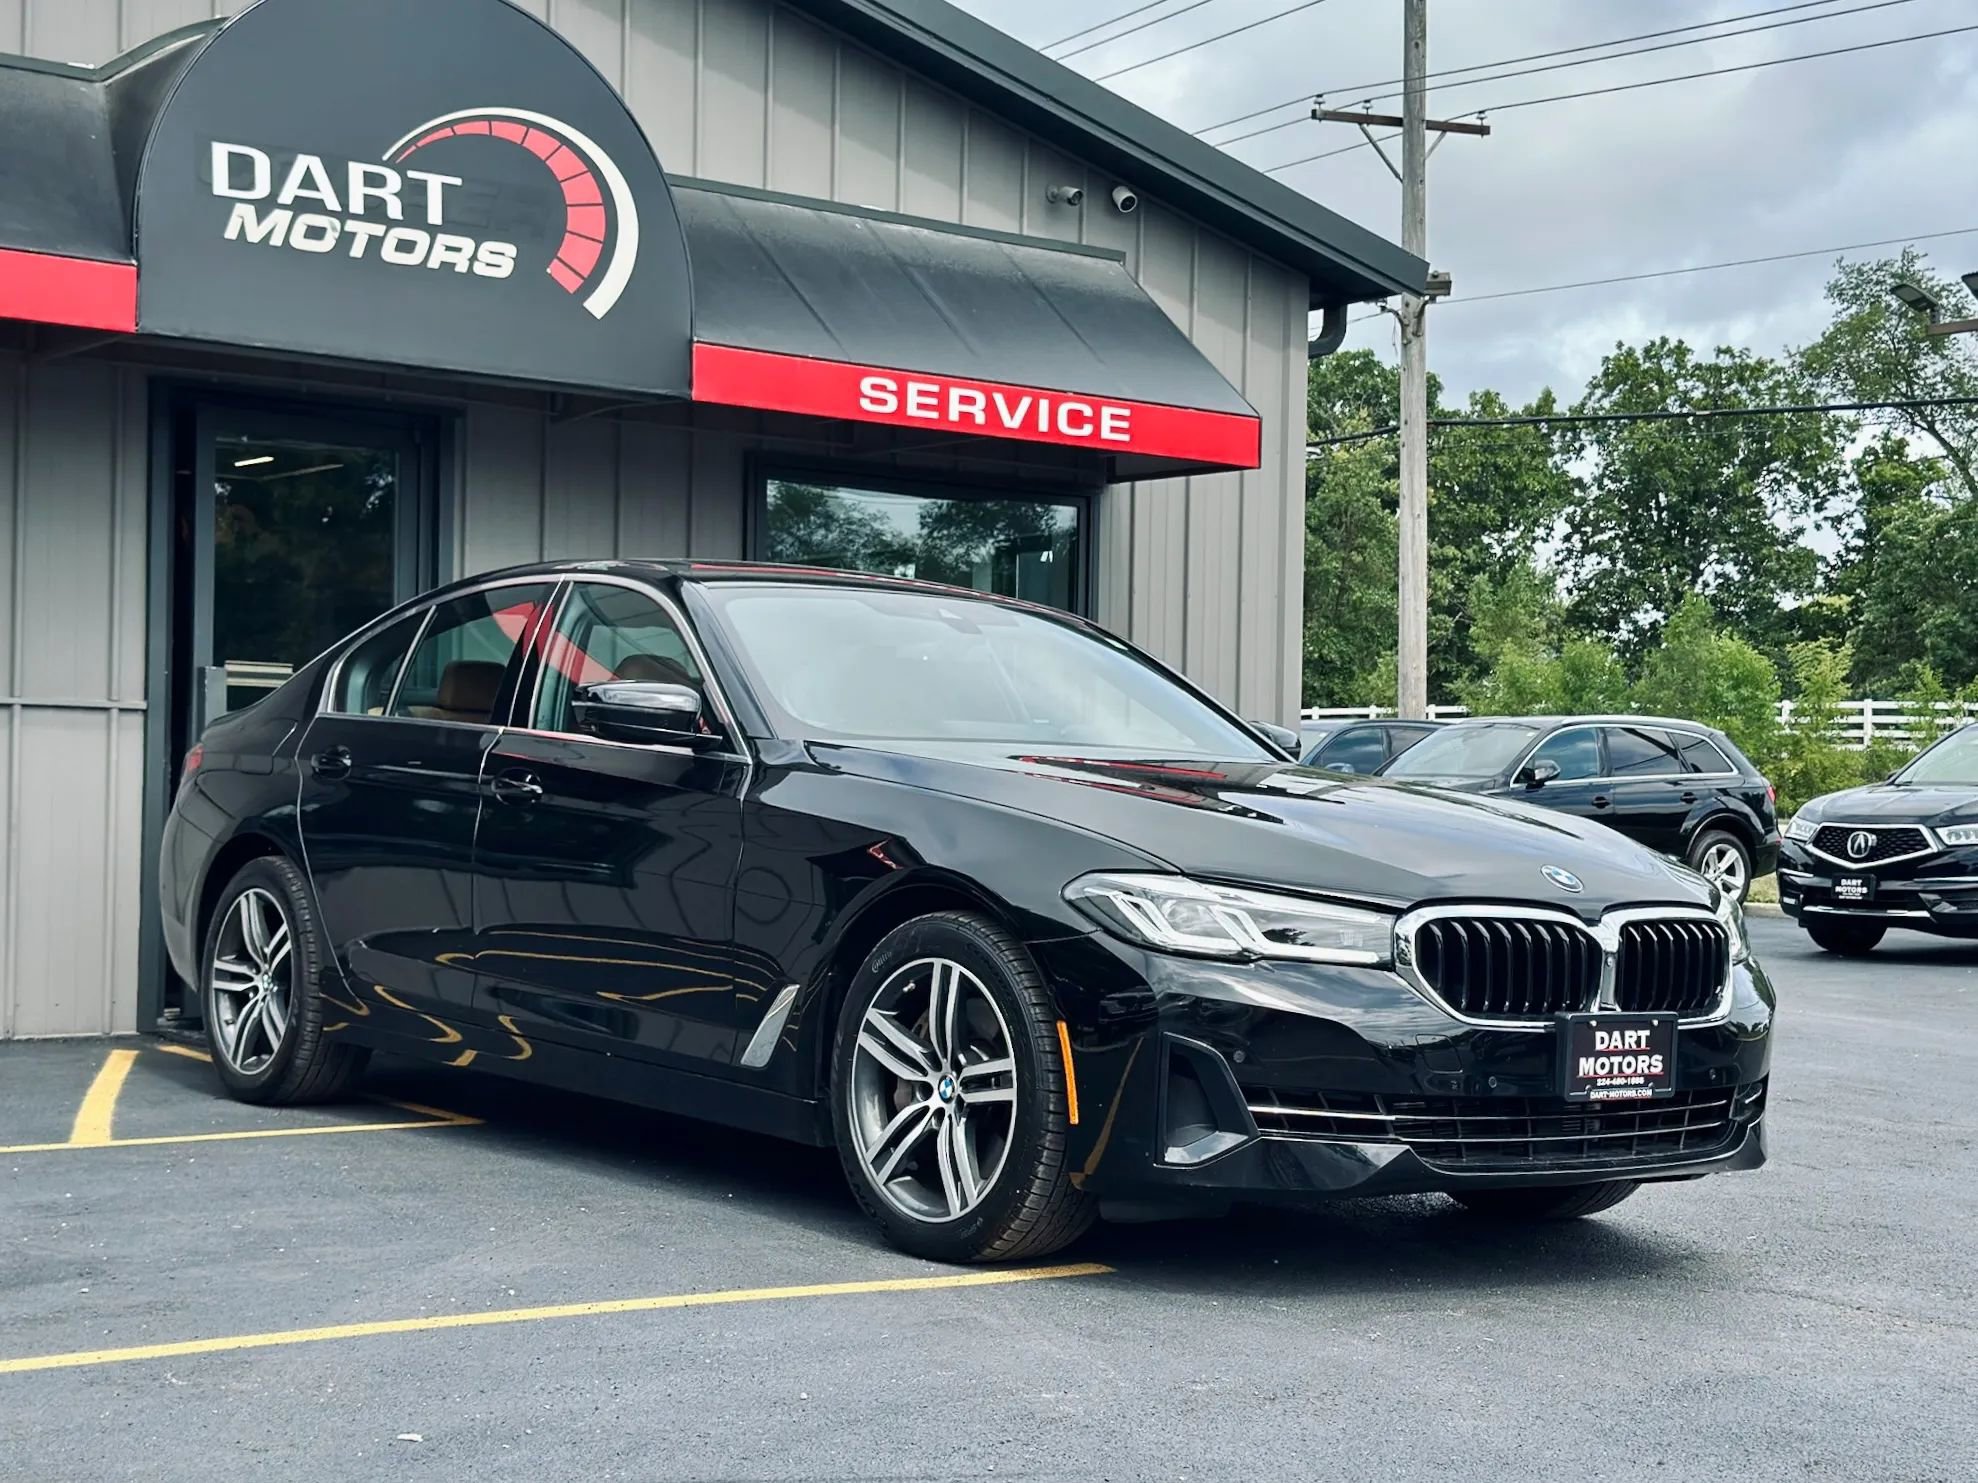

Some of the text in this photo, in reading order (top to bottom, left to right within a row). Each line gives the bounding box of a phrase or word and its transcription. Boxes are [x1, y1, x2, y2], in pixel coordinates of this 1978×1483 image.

[211, 141, 463, 226] DART
[223, 202, 518, 279] MOTORS
[859, 376, 1132, 442] SERVICE
[1840, 878, 1863, 886] DART
[1594, 1030, 1651, 1050] DART
[1578, 1054, 1664, 1077] MOTORS
